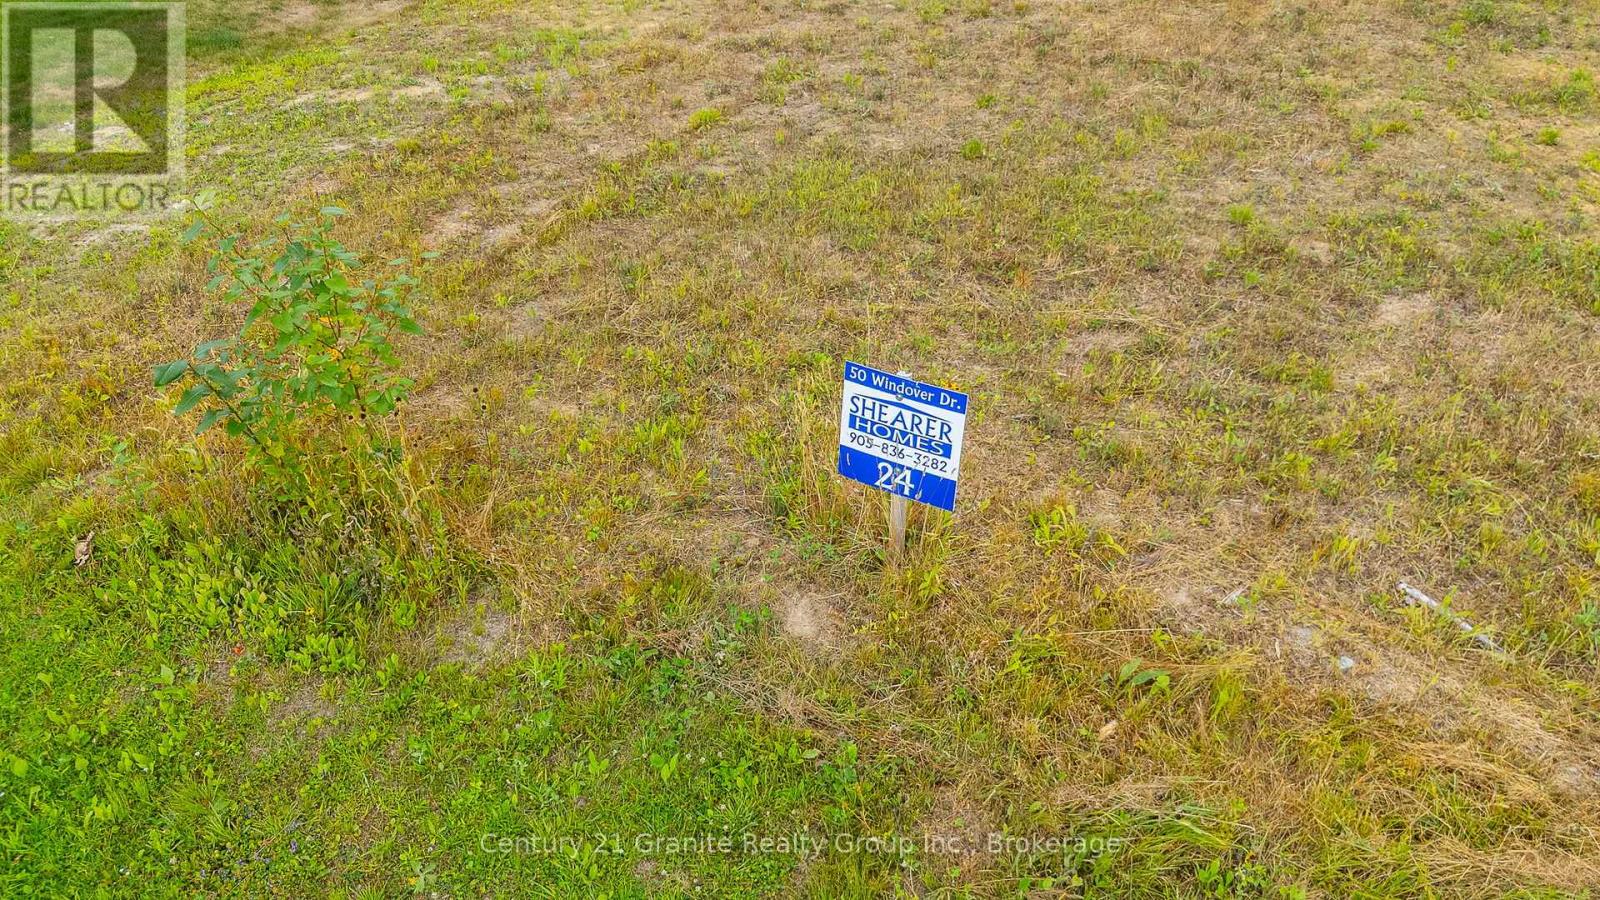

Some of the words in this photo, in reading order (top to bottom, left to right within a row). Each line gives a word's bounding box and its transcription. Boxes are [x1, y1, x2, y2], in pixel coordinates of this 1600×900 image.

[849, 367, 867, 382] 50
[871, 373, 935, 402] Windover
[940, 392, 961, 410] Dr.
[849, 395, 953, 444] SHEARER
[855, 416, 944, 456] HOMES
[849, 431, 948, 473] 905-836-3282
[874, 461, 915, 496] 24
